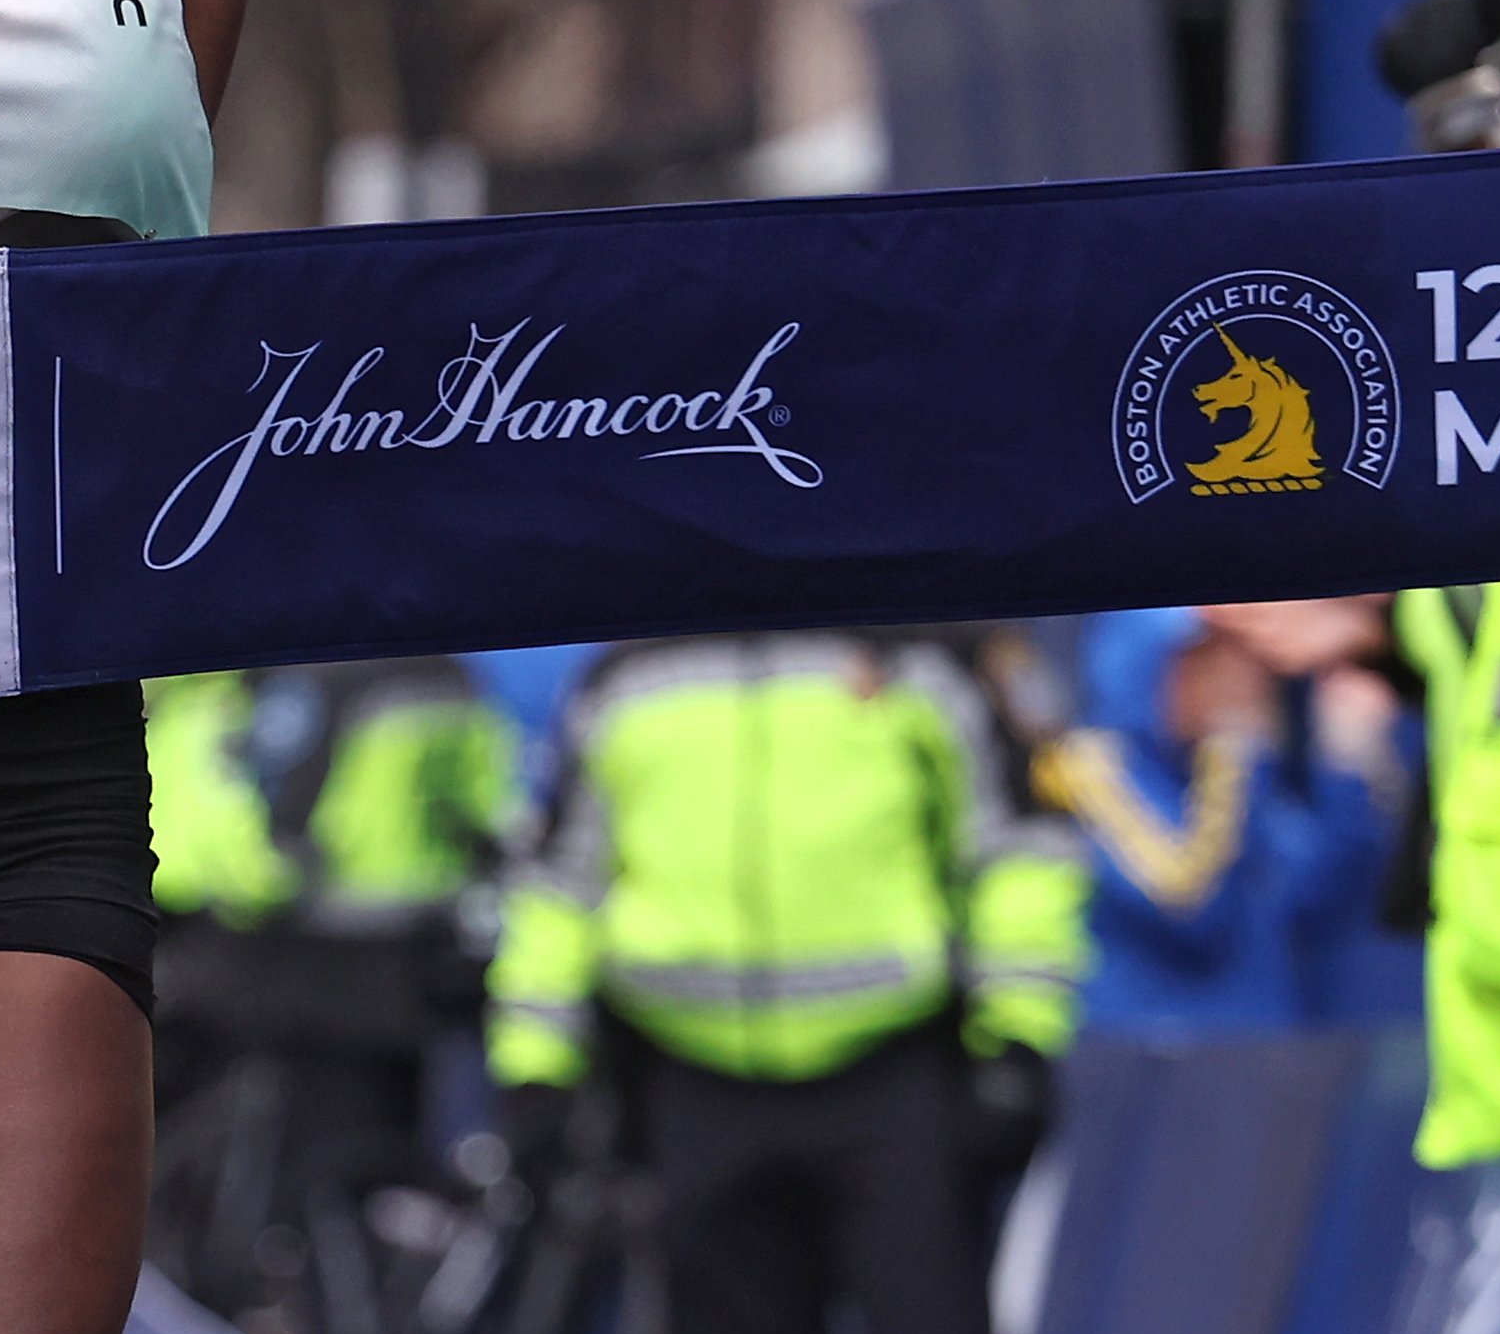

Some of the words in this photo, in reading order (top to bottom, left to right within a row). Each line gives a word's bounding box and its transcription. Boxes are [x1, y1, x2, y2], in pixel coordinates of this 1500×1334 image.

[142, 340, 405, 570] John
[1125, 356, 1165, 486] BOSTON
[1158, 283, 1290, 356] ATHLETIC
[1292, 292, 1388, 474] ASSOCIATION
